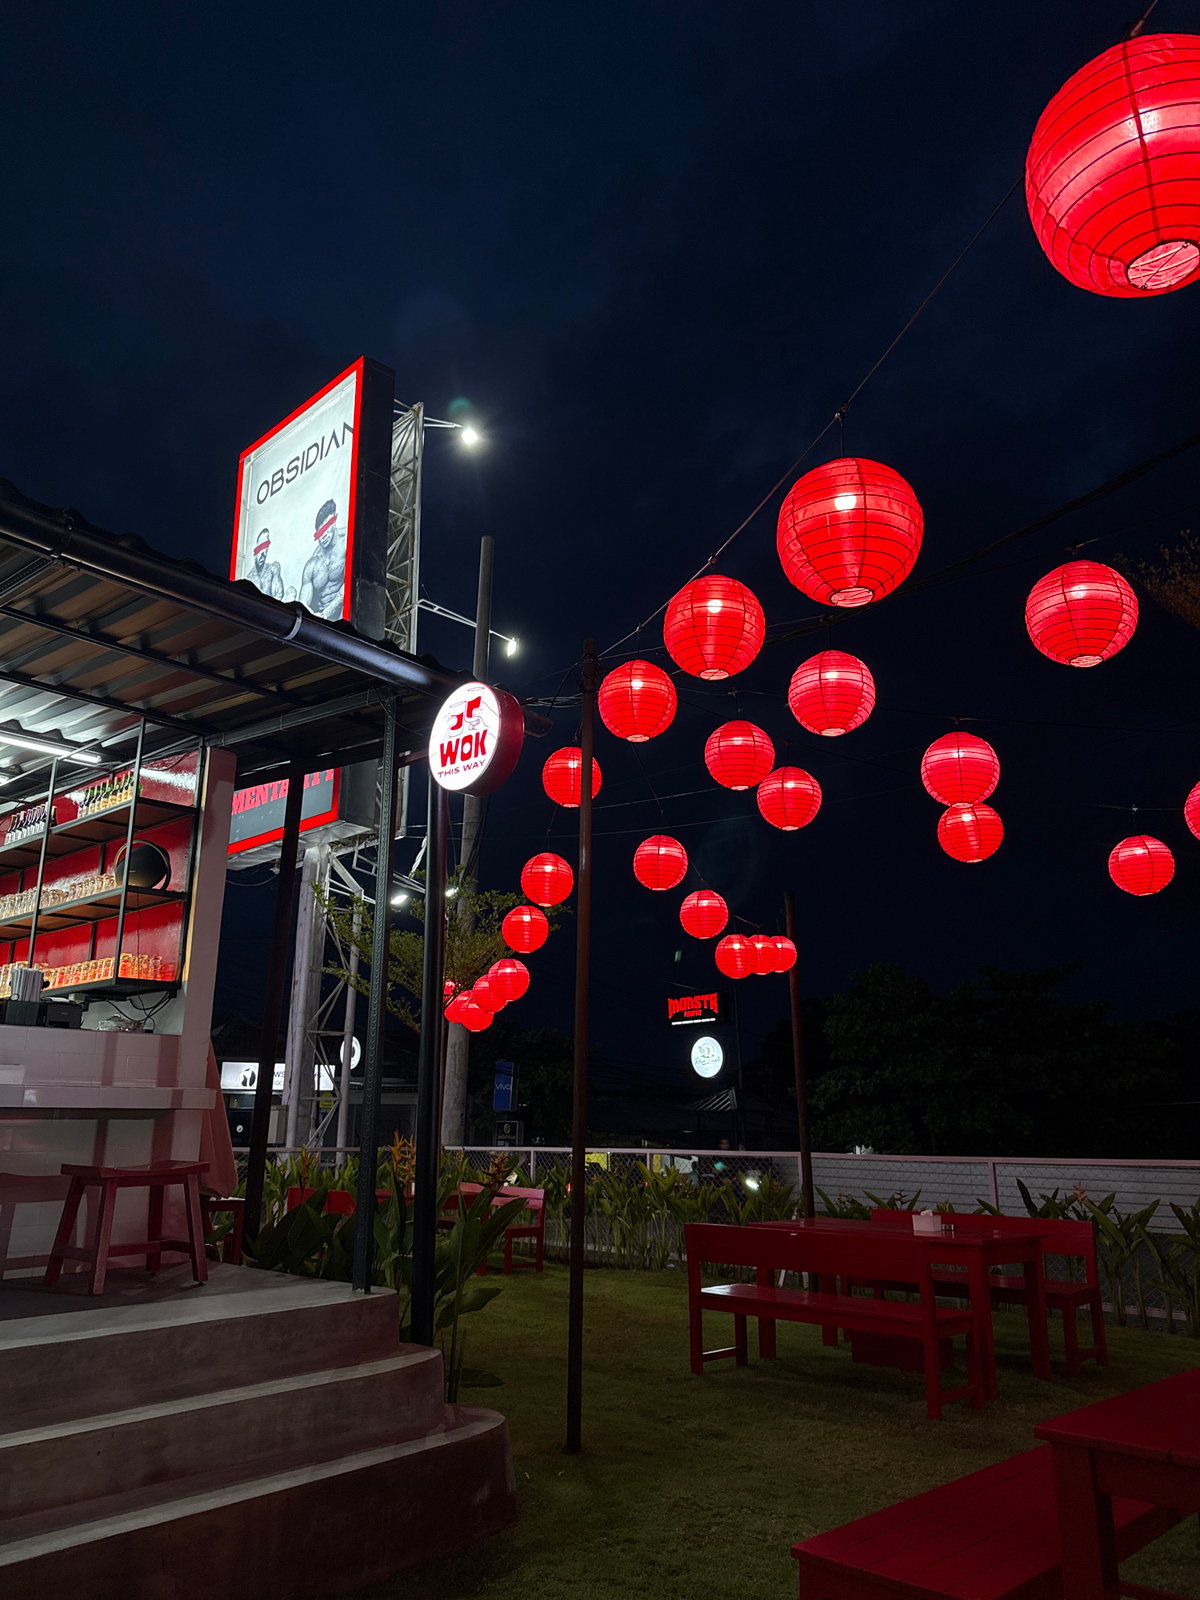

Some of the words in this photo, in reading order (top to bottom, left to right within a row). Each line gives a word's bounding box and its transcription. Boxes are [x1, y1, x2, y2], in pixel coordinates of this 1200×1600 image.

[256, 422, 354, 505] OBSIDIAN
[439, 729, 488, 767] WOK
[438, 767, 460, 778] THIS
[463, 759, 486, 772] WAY
